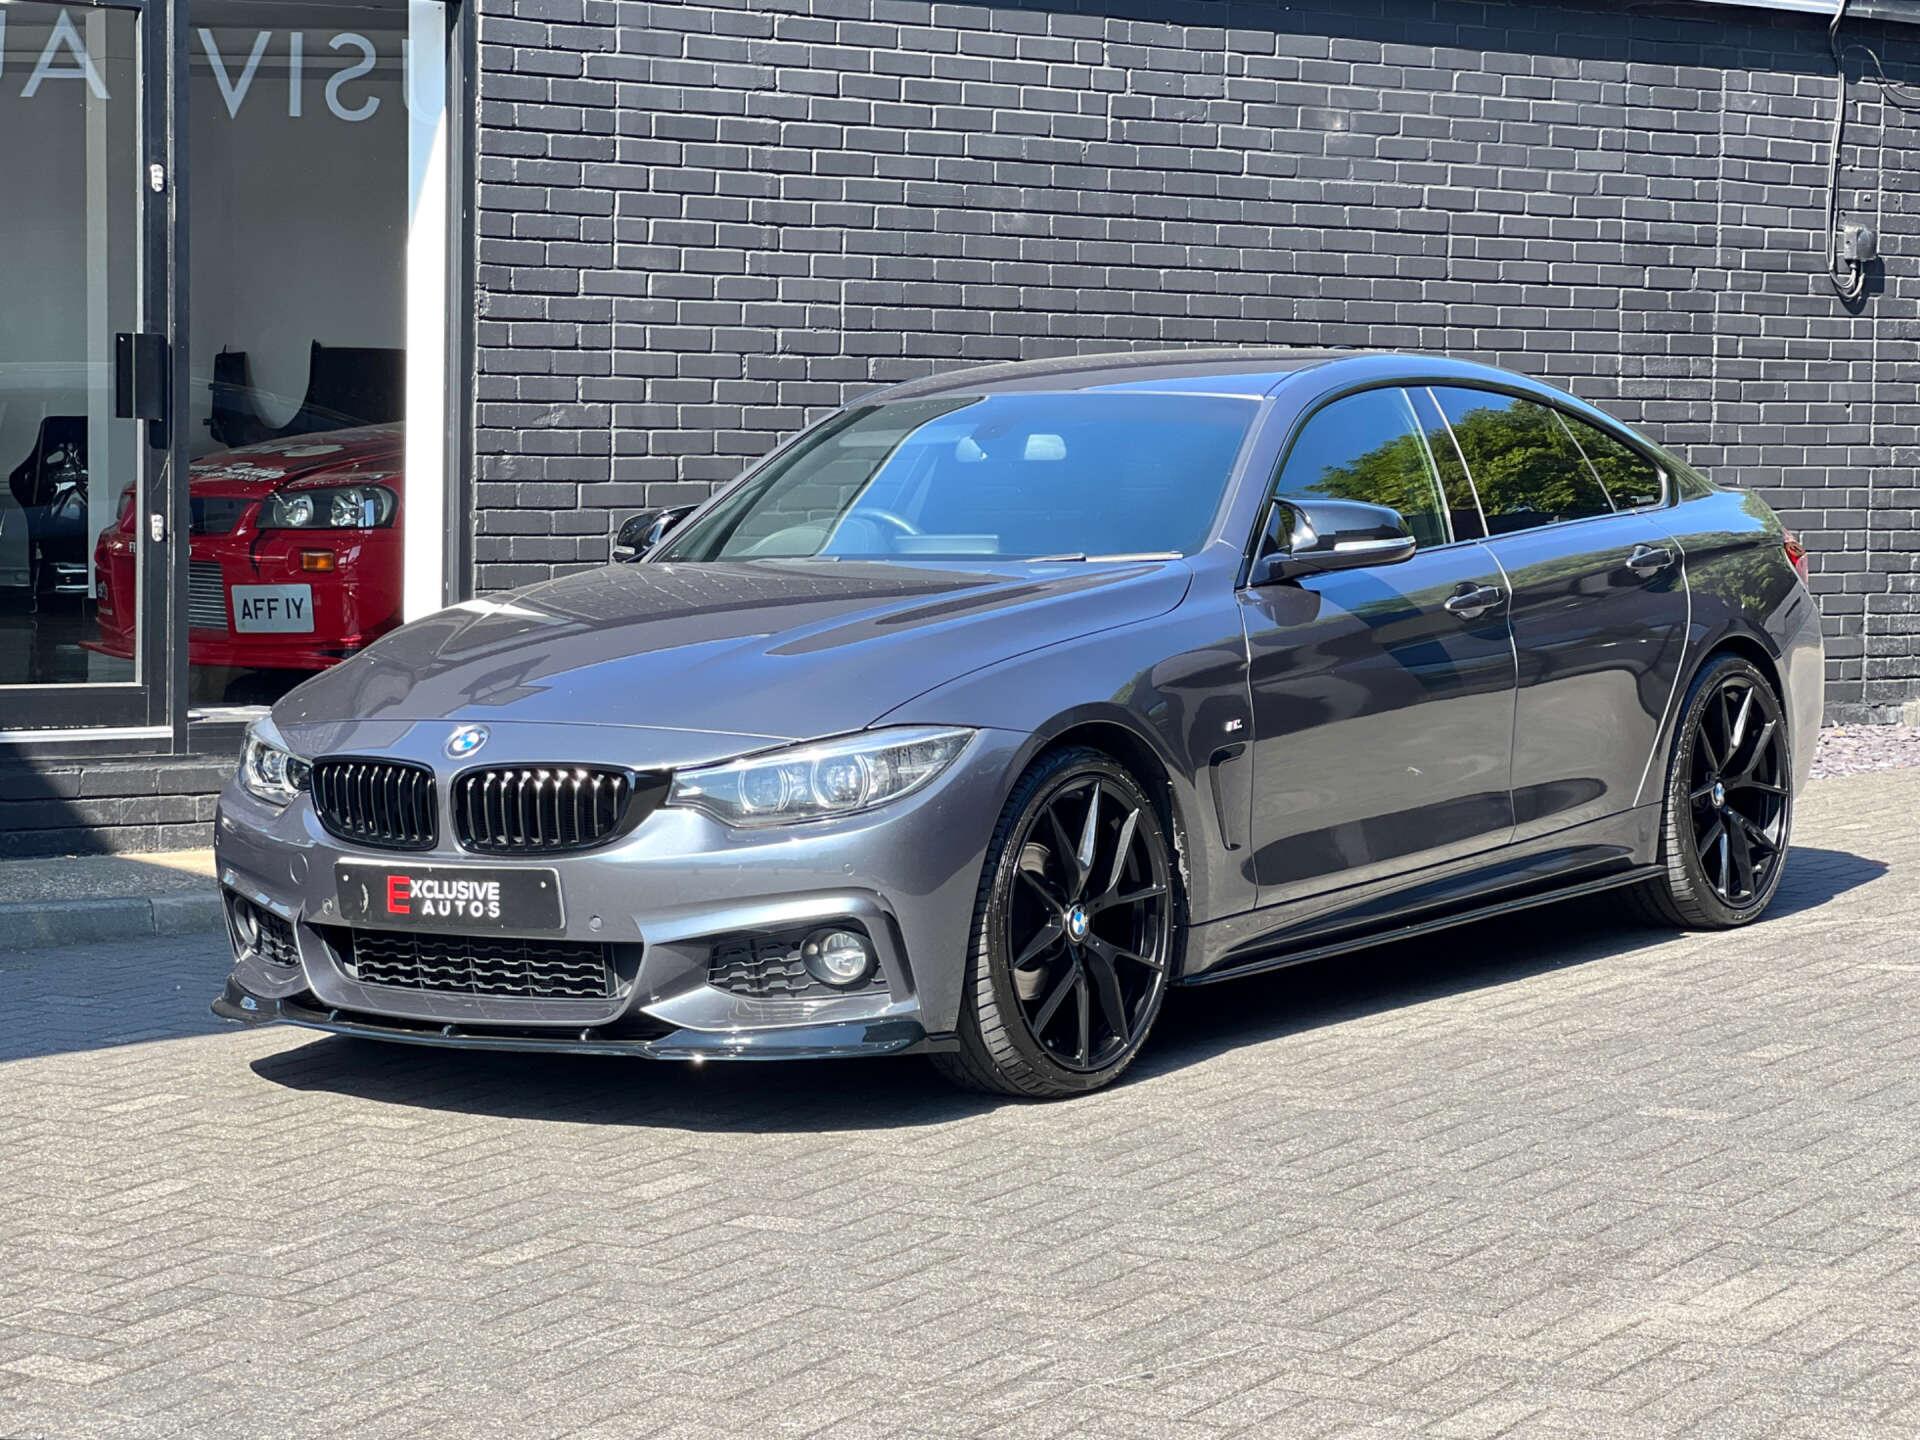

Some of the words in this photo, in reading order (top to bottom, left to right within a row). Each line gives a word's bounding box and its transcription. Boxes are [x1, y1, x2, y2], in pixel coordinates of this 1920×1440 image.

[242, 598, 279, 620] AFF
[387, 875, 500, 914] EXCLUSIVE
[422, 901, 500, 918] AUTOS
